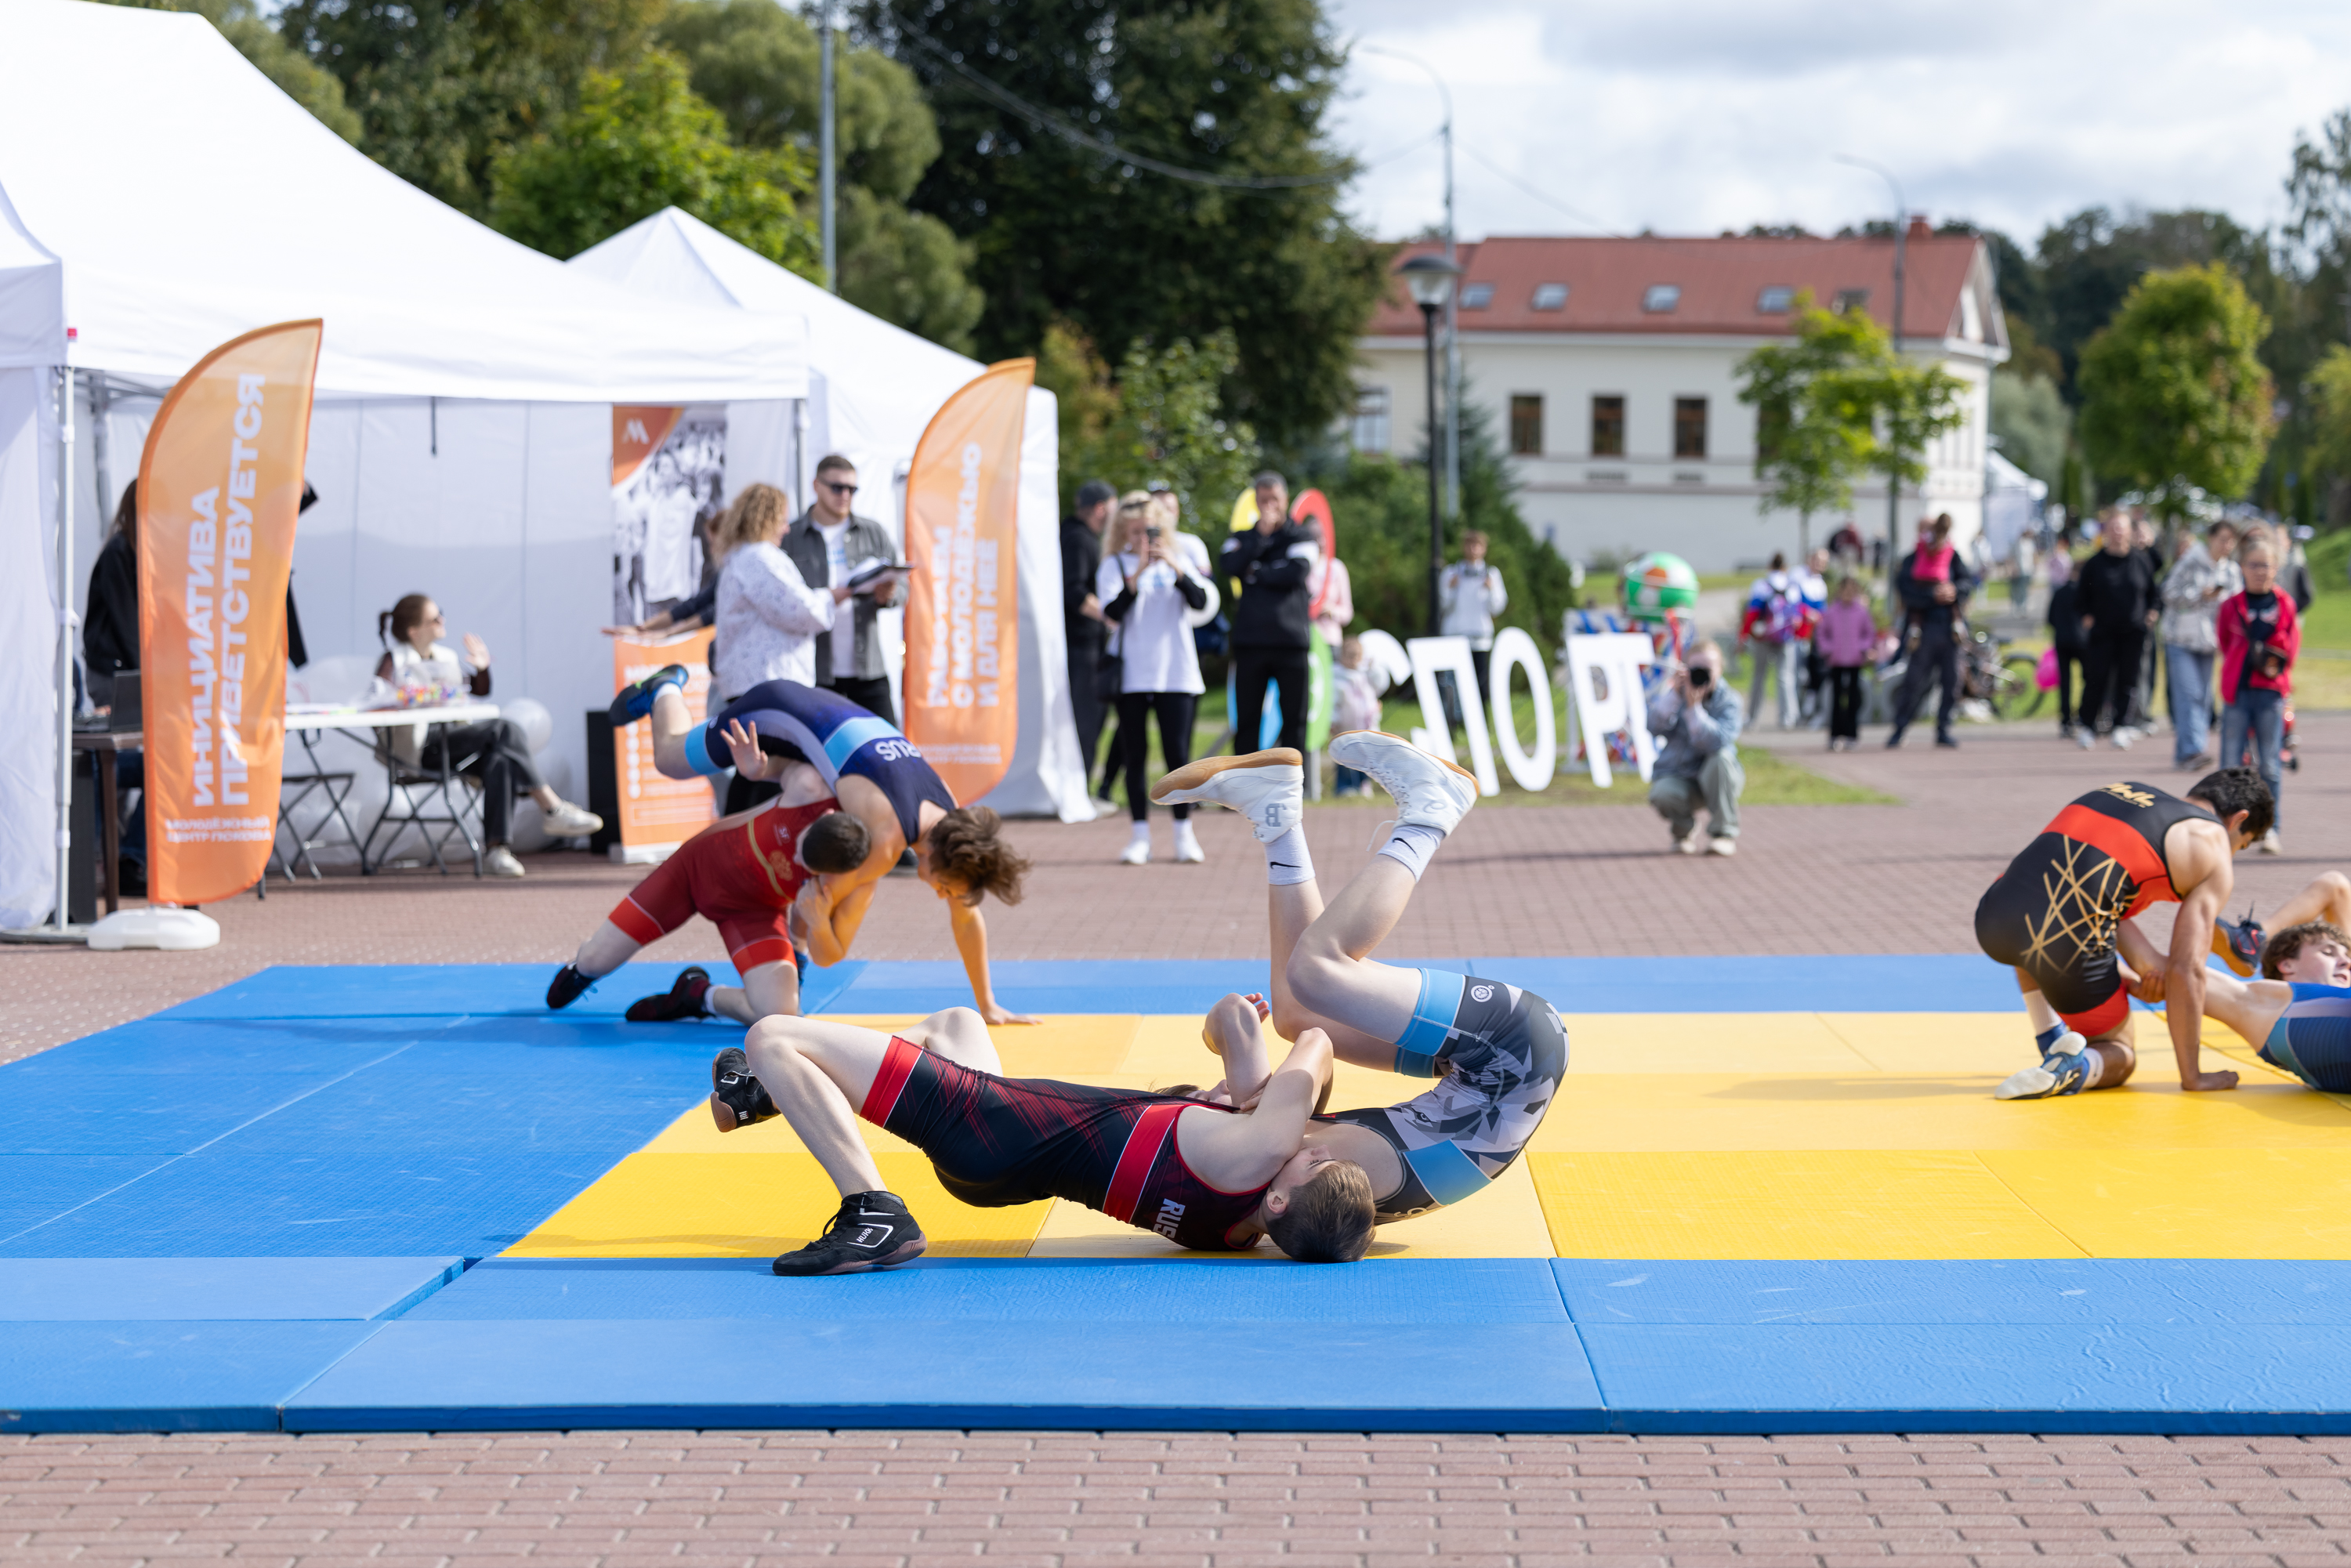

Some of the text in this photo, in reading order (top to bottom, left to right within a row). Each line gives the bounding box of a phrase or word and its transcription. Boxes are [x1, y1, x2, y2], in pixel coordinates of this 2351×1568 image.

[220, 373, 266, 806] ПРИВЕТСТВУЕТСЯ
[927, 525, 951, 708] РАБОТАЕМ
[186, 486, 219, 806] ИНИЦИАТИВА
[976, 610, 1000, 680] ДЛЯ
[951, 683, 974, 708] С
[977, 683, 999, 708] И
[875, 739, 922, 762] RUS
[1153, 1198, 1186, 1238] RUS
